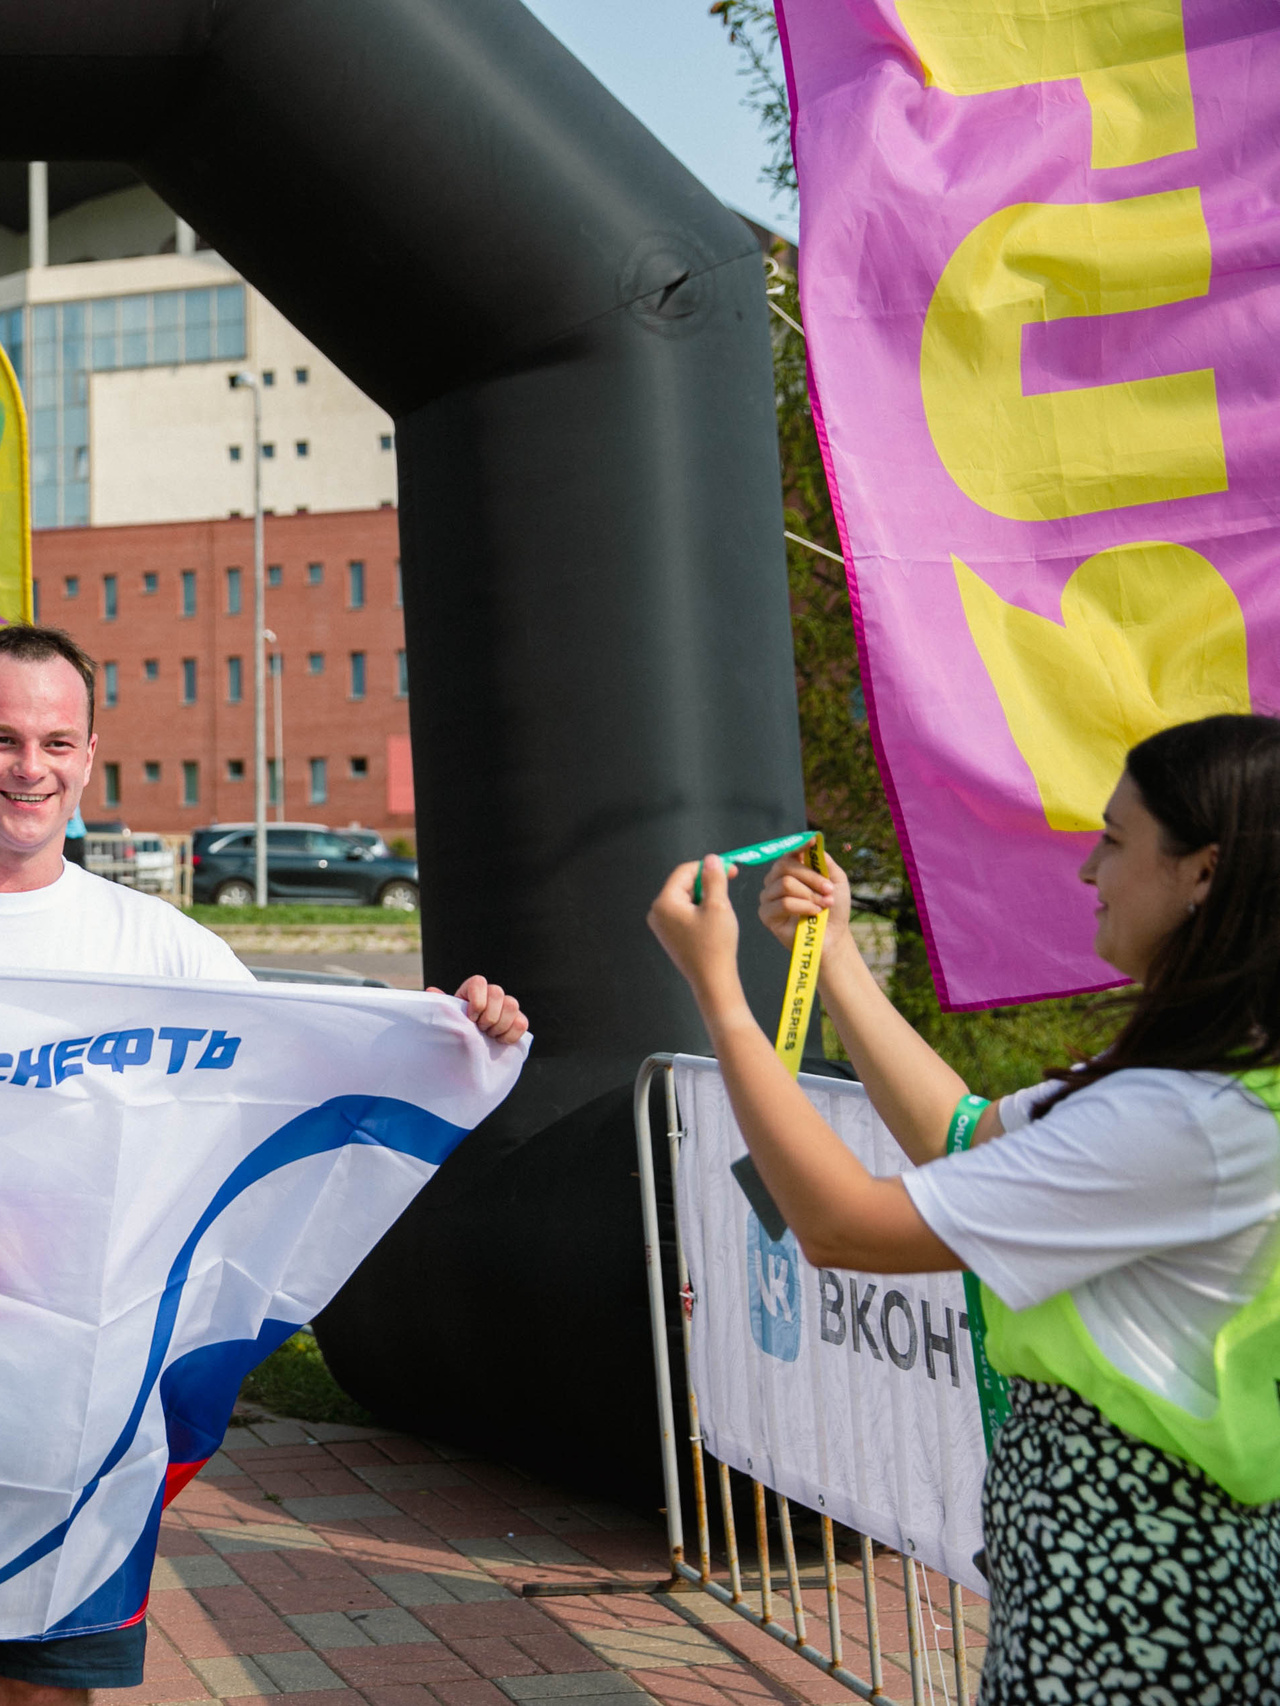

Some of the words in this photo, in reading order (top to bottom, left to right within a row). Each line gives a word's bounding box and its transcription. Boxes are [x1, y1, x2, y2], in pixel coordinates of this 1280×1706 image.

[795, 950, 812, 993] TRAIL
[784, 998, 804, 1051] SERIES
[819, 1267, 969, 1389] ВКОН
